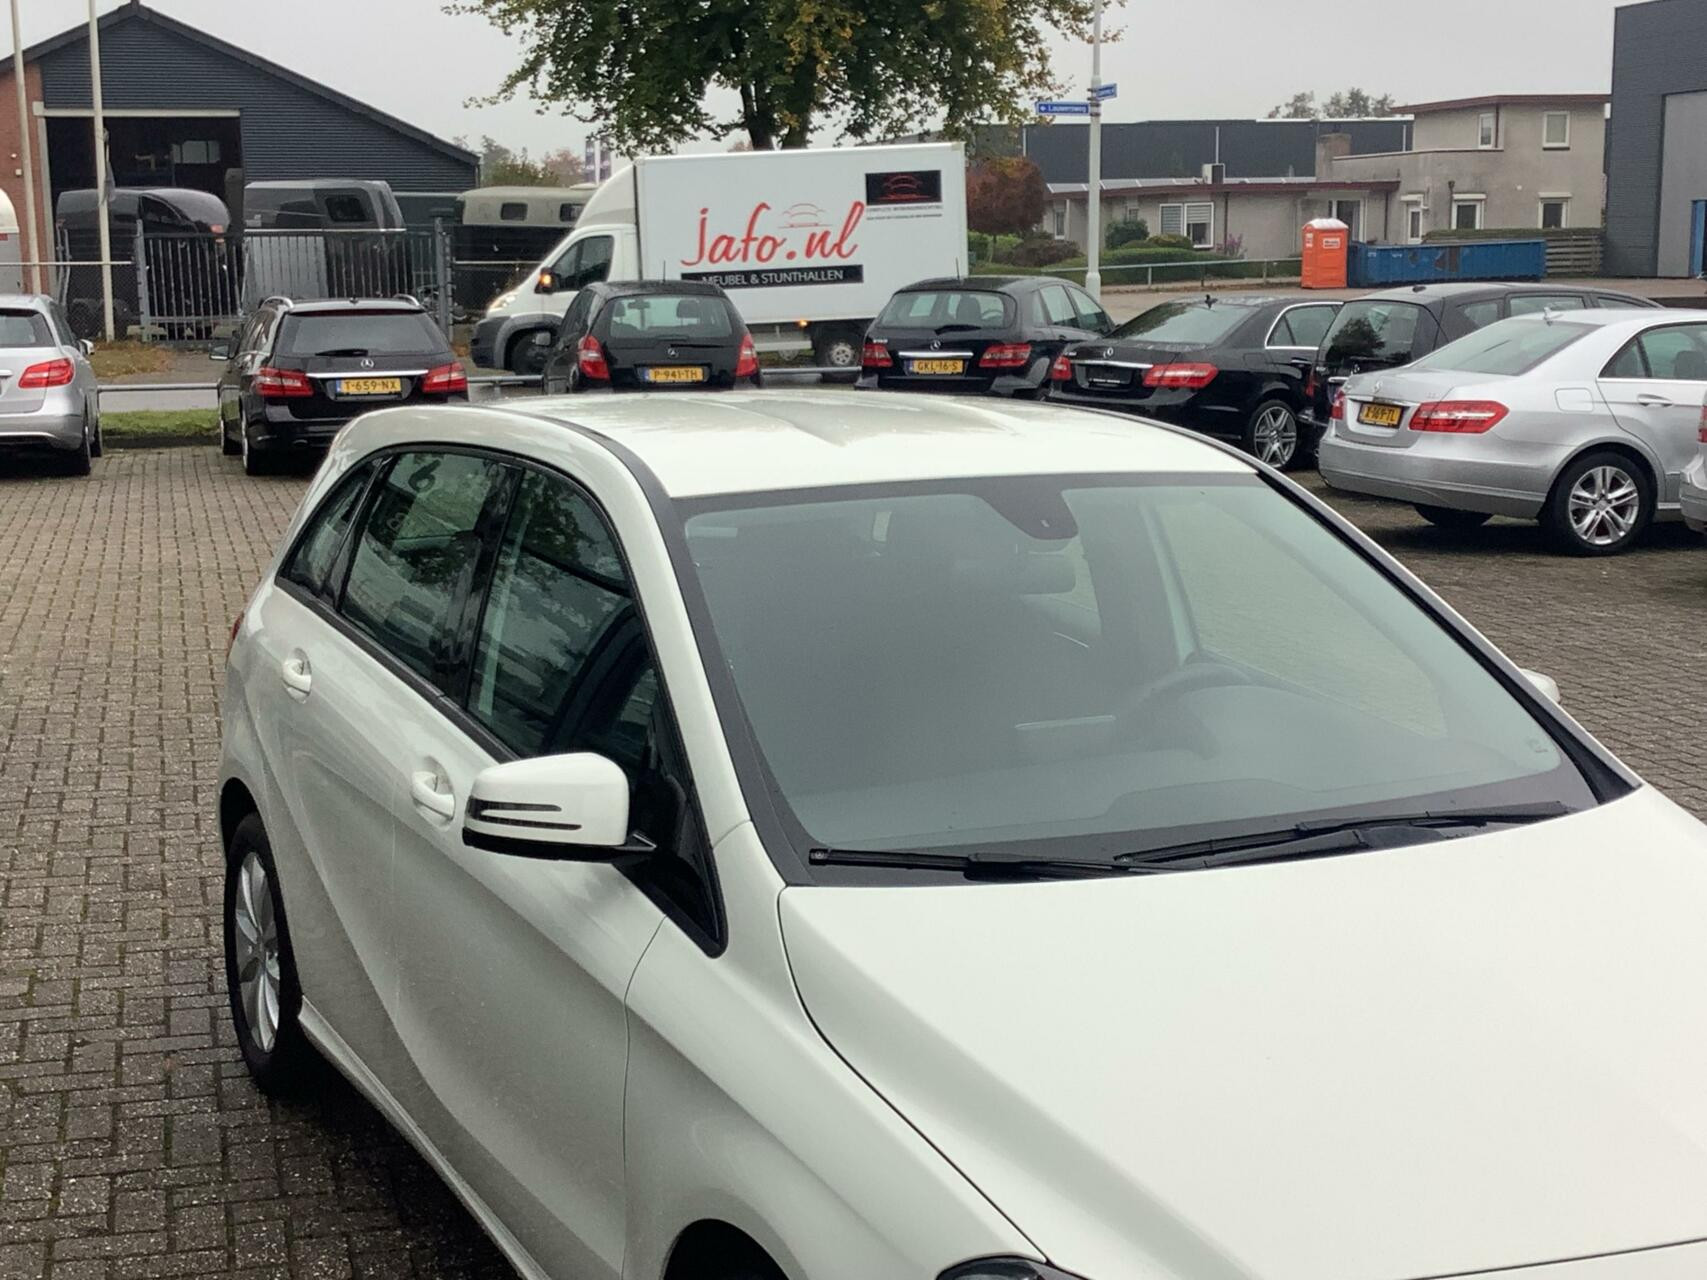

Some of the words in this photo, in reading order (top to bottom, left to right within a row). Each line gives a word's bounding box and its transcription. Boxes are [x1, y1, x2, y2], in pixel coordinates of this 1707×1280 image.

[680, 201, 865, 266] jafo.nl
[750, 273, 759, 284] &
[761, 270, 843, 284] STUNTHALLEN
[918, 361, 958, 370] GKL-16-S
[654, 369, 698, 379] P-941-TH
[345, 380, 397, 391] T-659-NX
